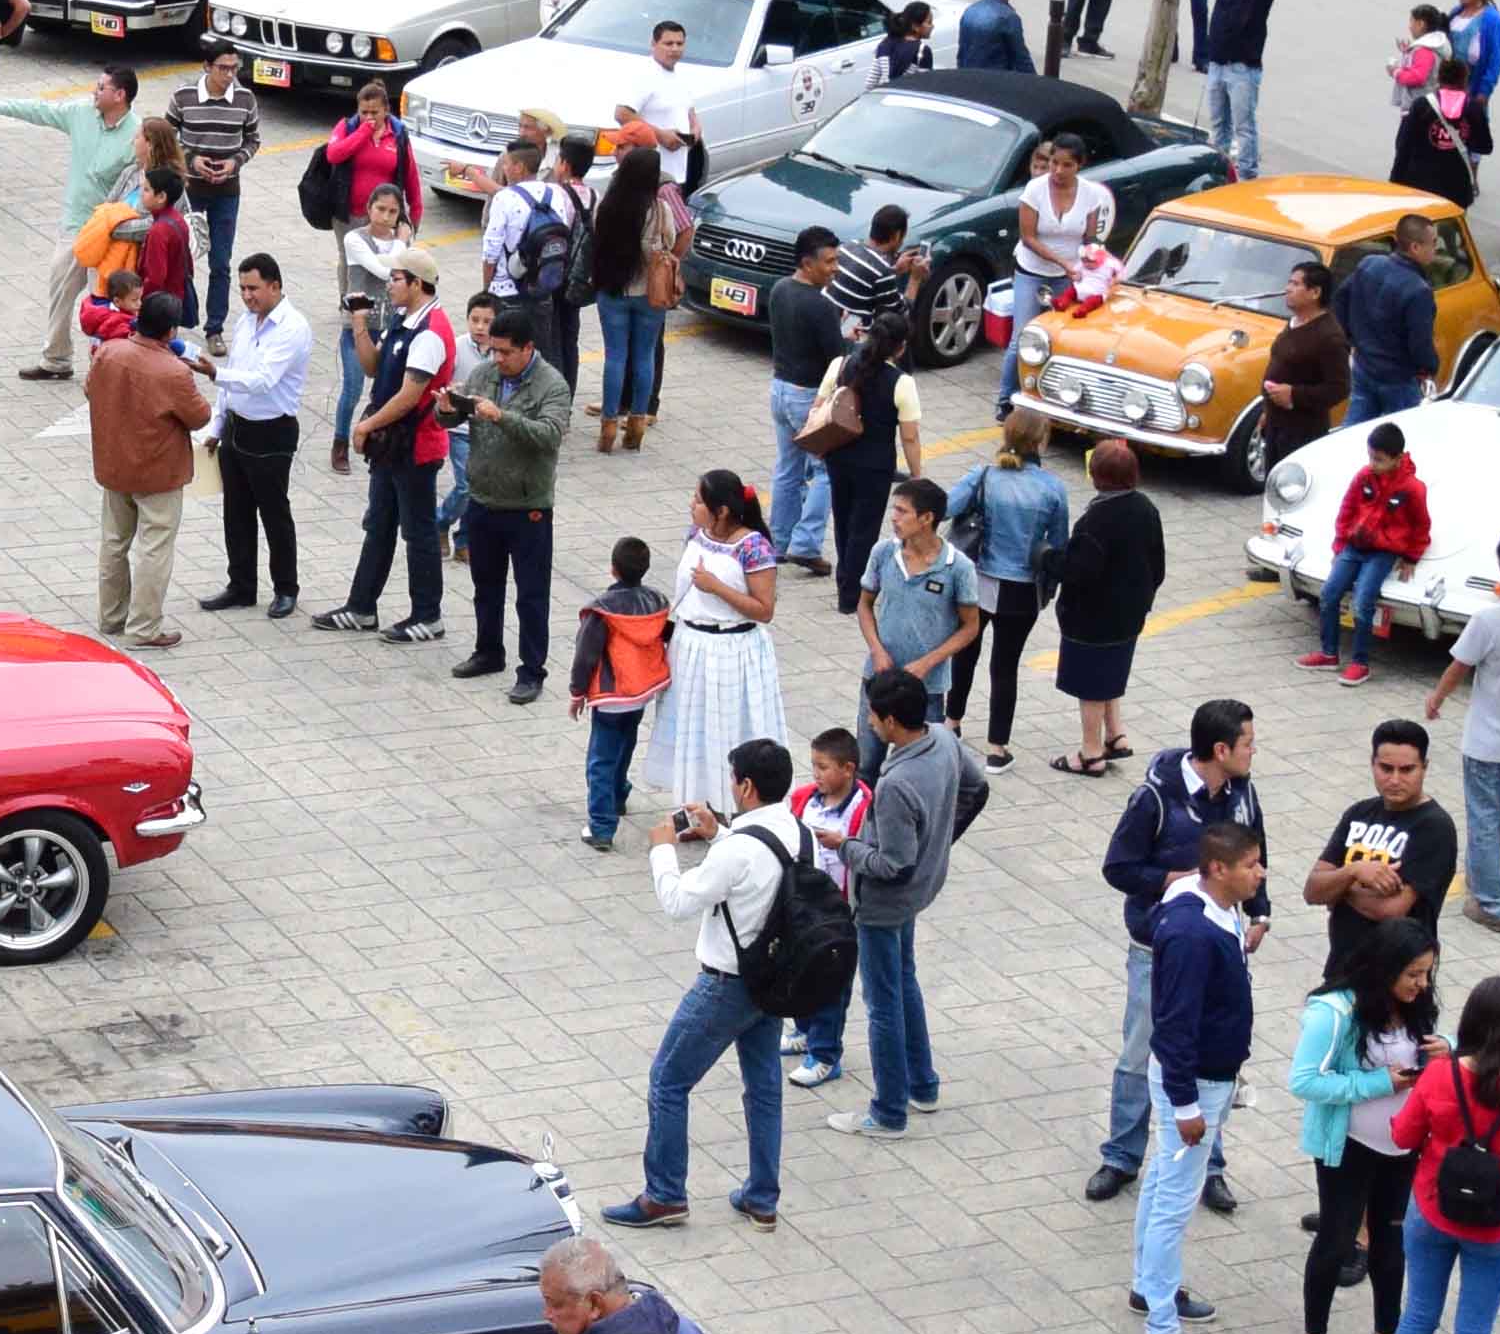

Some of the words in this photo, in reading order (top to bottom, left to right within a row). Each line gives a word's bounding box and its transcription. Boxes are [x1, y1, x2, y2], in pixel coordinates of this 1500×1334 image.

[100, 17, 118, 29] 40
[725, 287, 747, 304] 43
[1345, 820, 1409, 859] POLO
